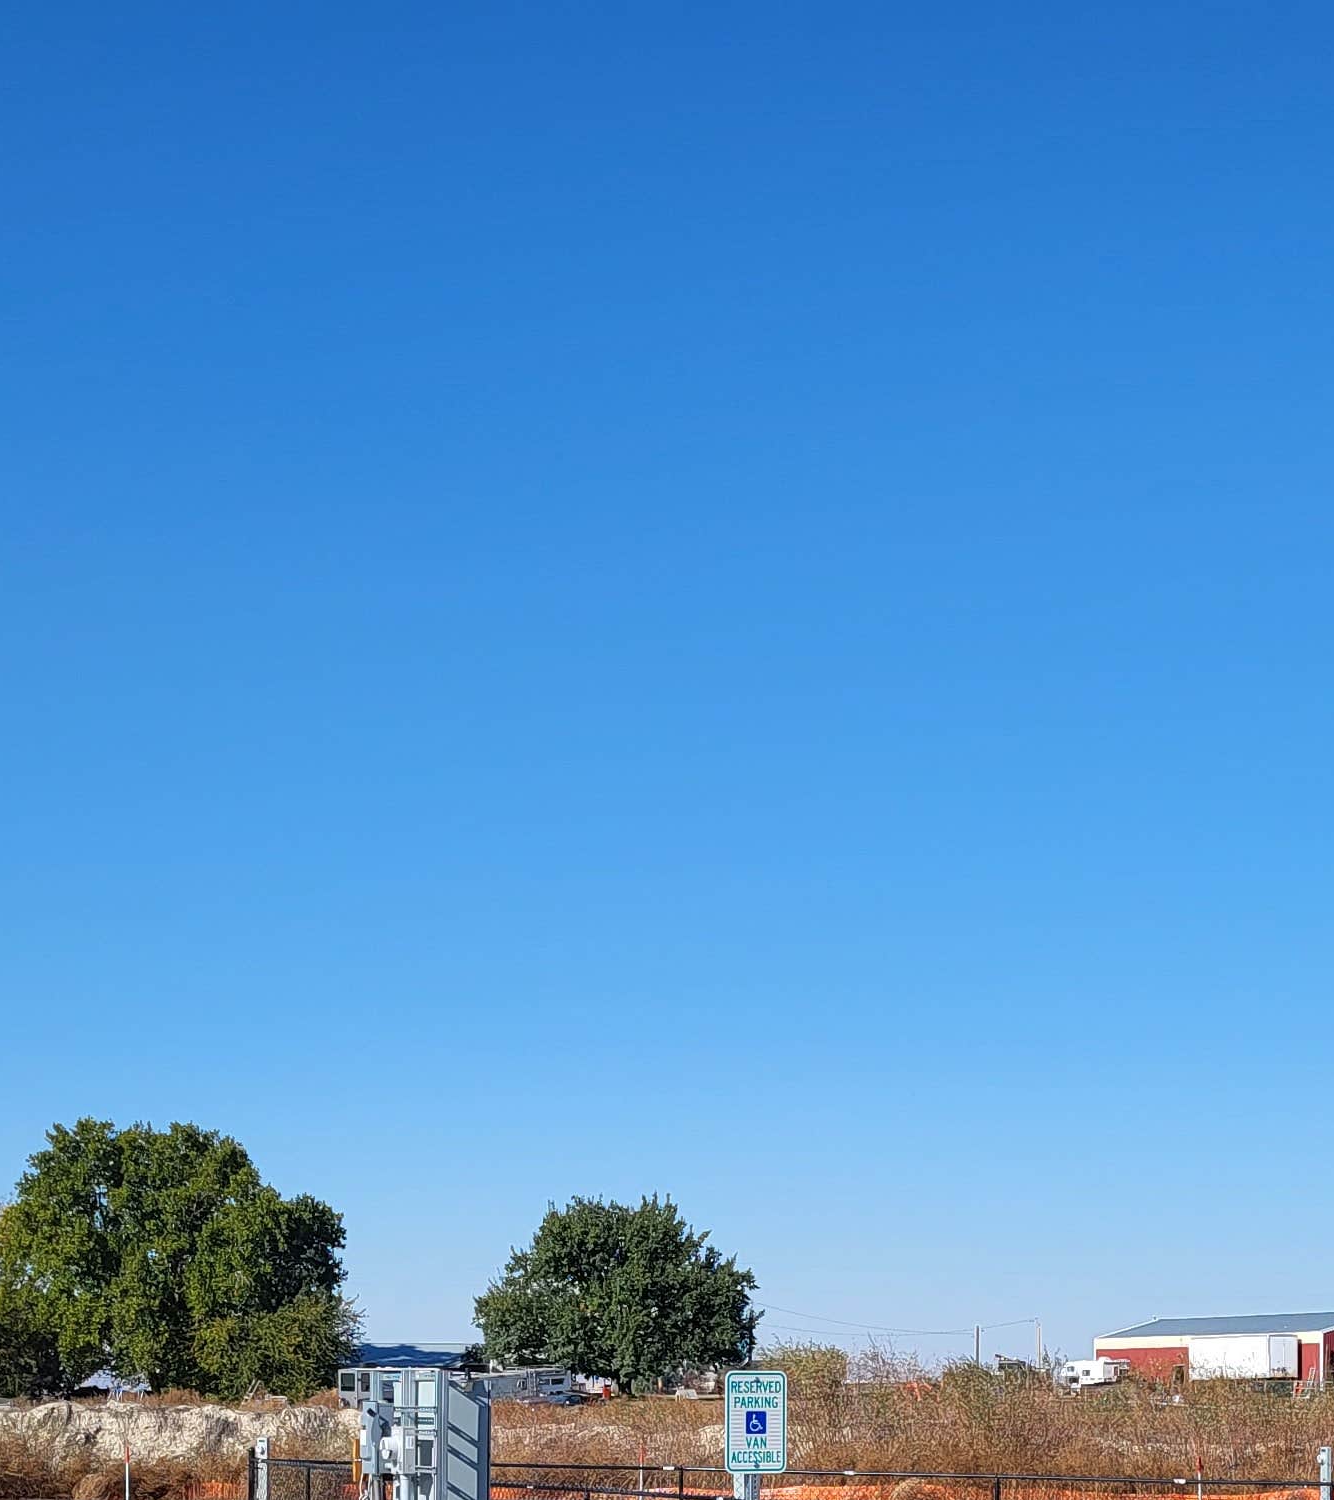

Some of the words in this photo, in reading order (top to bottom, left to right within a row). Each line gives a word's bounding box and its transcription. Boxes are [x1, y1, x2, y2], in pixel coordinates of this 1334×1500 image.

[731, 1381, 782, 1394] RESERVED
[733, 1396, 779, 1409] PARKING
[746, 1437, 767, 1449] VAN
[731, 1451, 781, 1464] ACCESSIBLE
